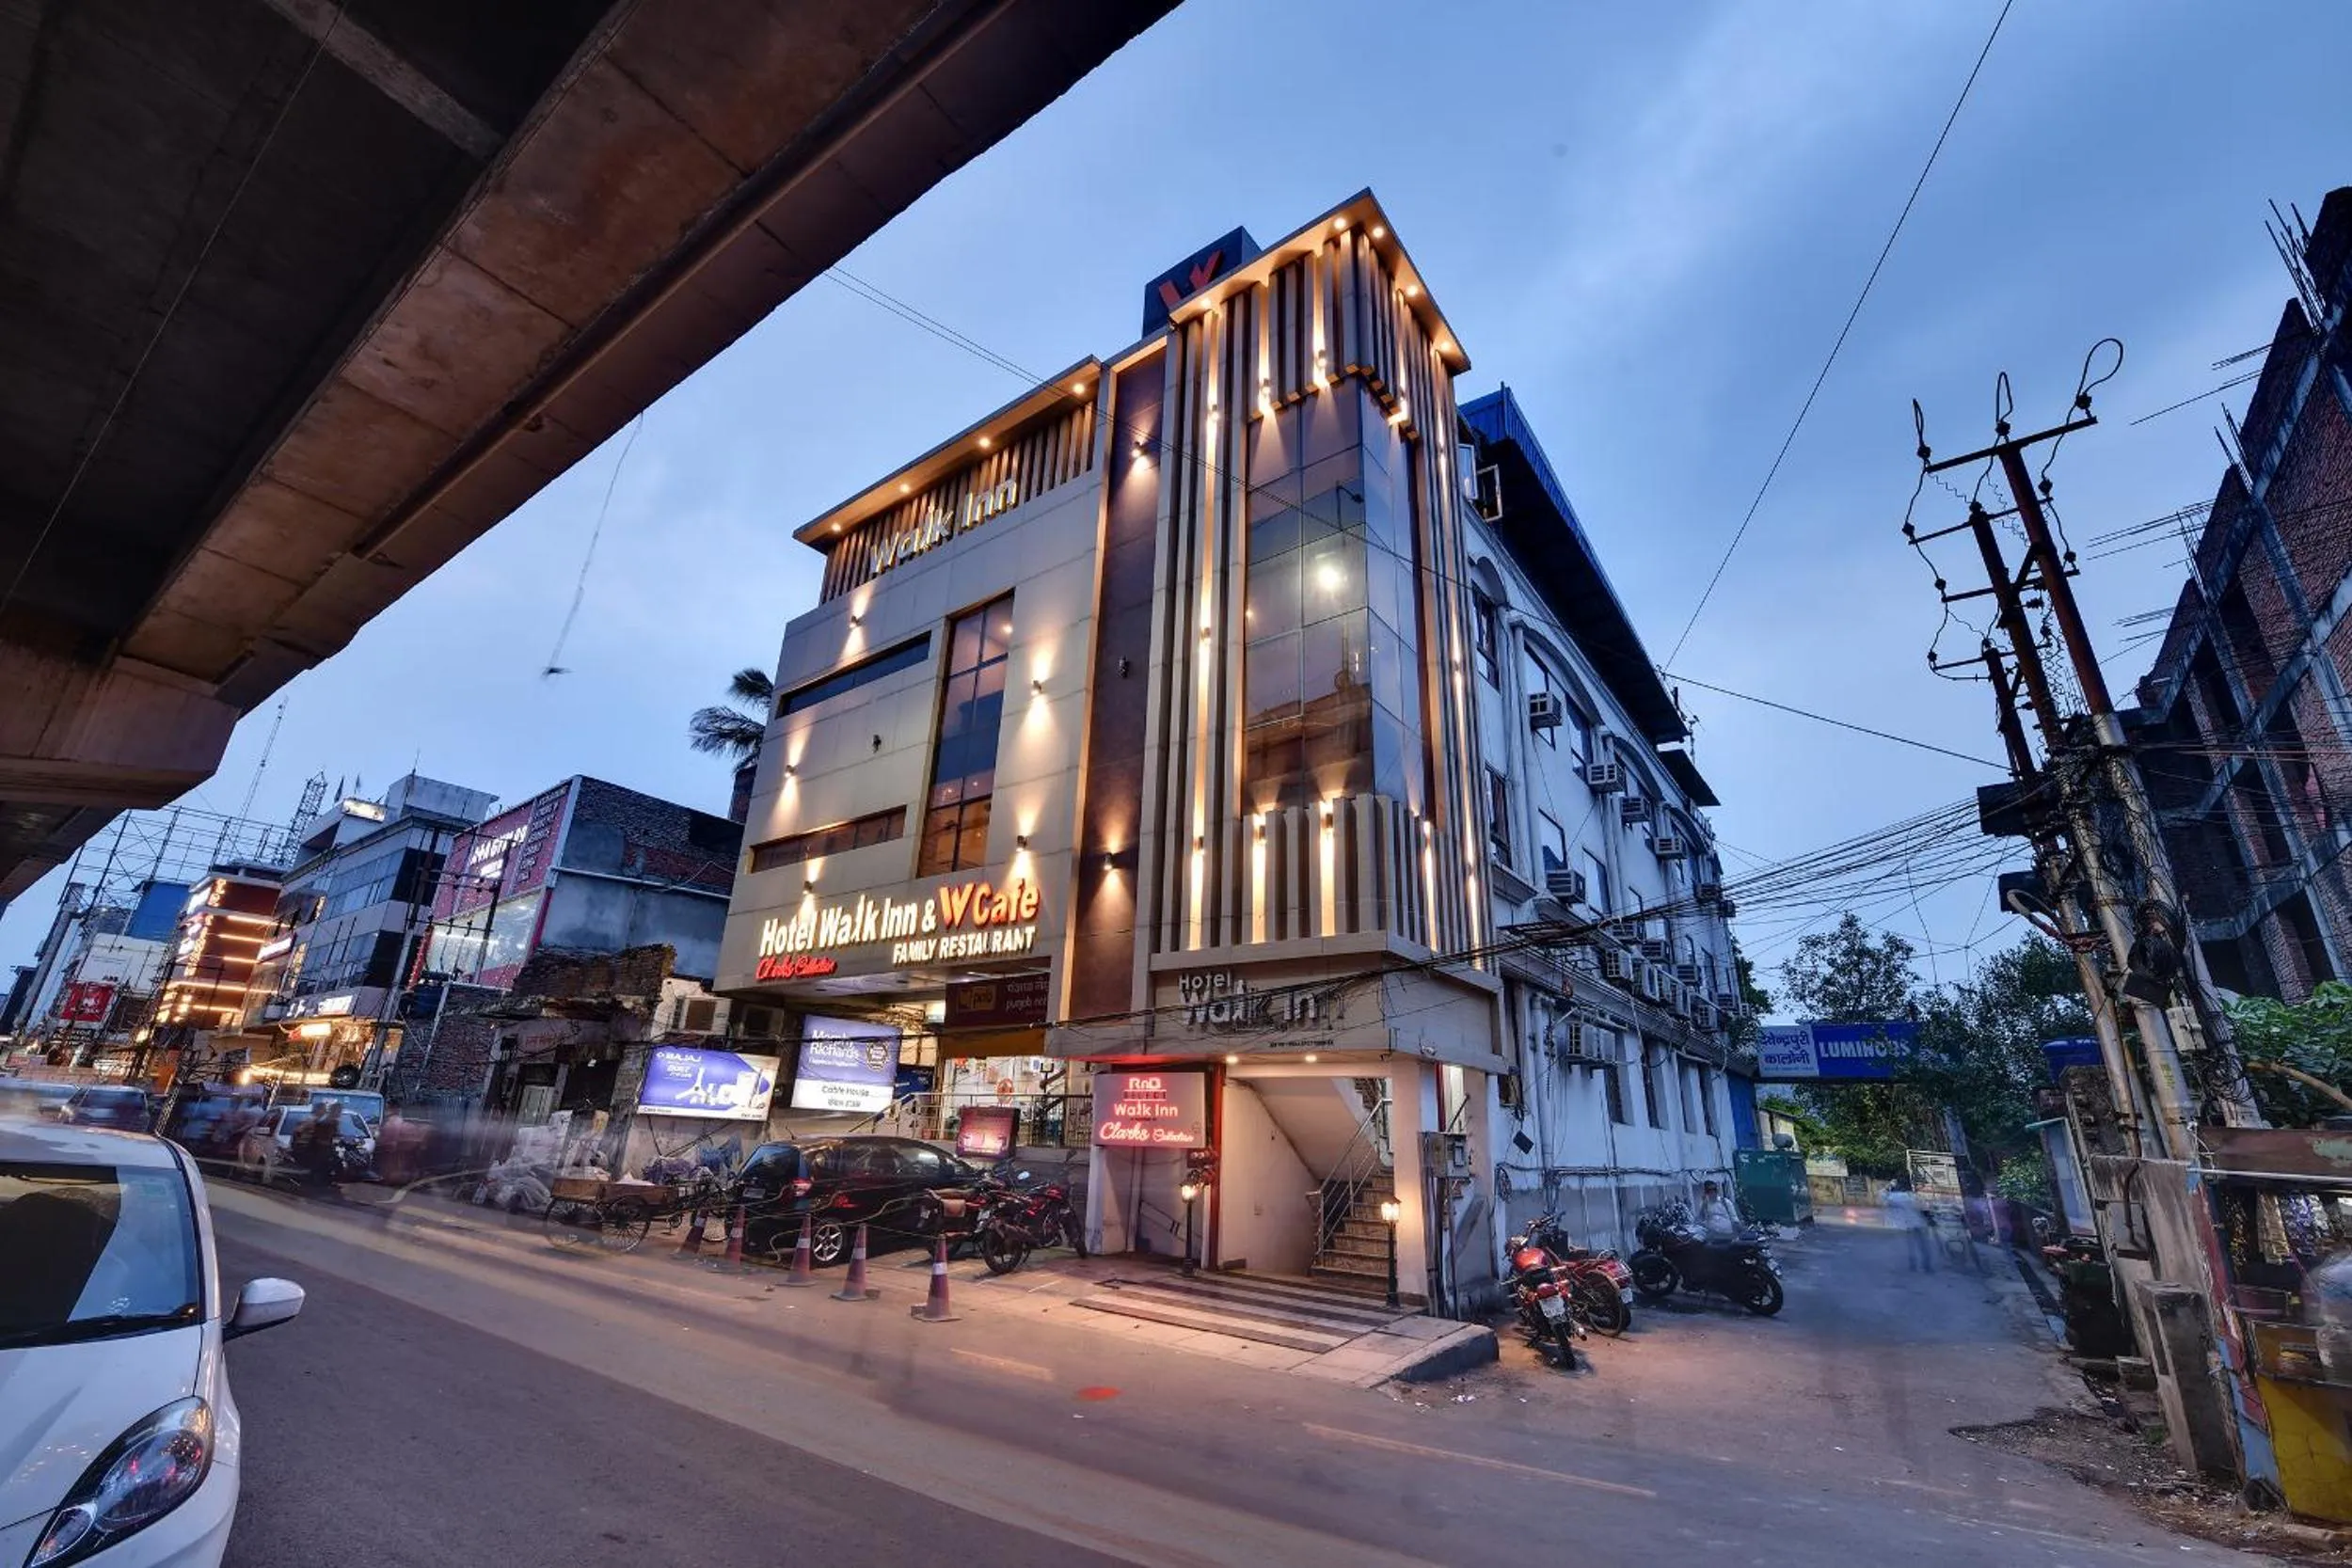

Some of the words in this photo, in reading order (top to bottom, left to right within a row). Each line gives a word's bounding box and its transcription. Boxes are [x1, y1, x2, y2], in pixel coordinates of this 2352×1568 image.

[870, 505, 954, 573] Walk
[961, 480, 1017, 531] Inn
[758, 910, 818, 957] Hotel
[819, 894, 880, 948] Walk
[881, 897, 918, 940] Inn
[921, 899, 937, 934] &
[893, 939, 938, 964] FAMILY
[1178, 972, 1232, 990] Hotel
[809, 1041, 860, 1060] Richards
[1114, 1100, 1152, 1117] Walk
[1154, 1103, 1179, 1117] Inn
[1099, 1120, 1150, 1142] Clarks
